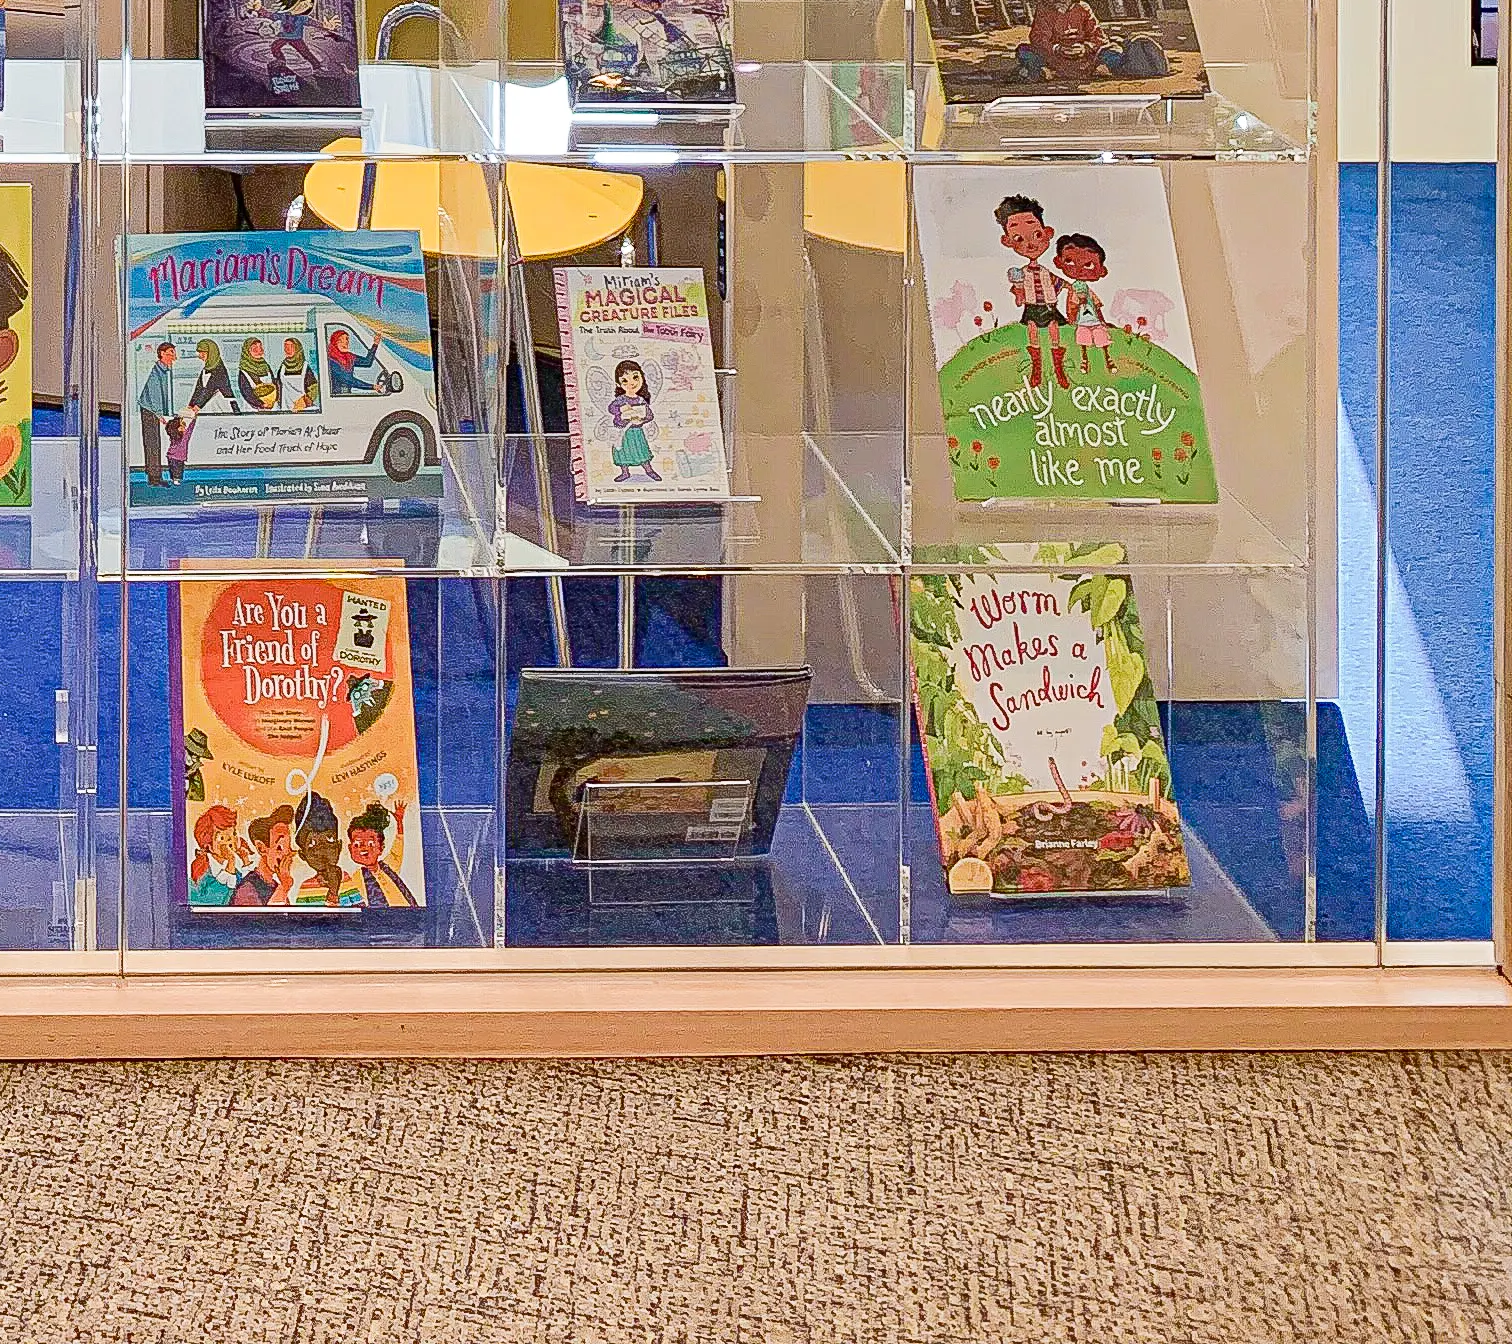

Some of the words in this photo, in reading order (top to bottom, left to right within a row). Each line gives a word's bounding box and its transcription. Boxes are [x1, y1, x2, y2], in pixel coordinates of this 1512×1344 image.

[148, 246, 281, 303] Mariam's
[286, 247, 384, 309] Dream
[604, 273, 660, 290] Miriam's
[585, 286, 686, 308] MAGICAL
[579, 326, 593, 334] The
[580, 306, 657, 323] CREATURE
[662, 305, 699, 318] FILES
[969, 375, 1054, 429] nearly
[1071, 384, 1176, 435] exactly
[230, 426, 256, 441] Story
[1035, 414, 1128, 447] almost
[217, 446, 233, 454] and
[236, 444, 252, 454] Her
[254, 443, 276, 454] Food
[278, 444, 303, 454] Truck
[1030, 449, 1084, 486] like
[1094, 456, 1144, 485] me
[232, 597, 266, 626] Are
[264, 592, 309, 631] You
[316, 603, 327, 625] a
[346, 595, 387, 611] WANTED
[970, 588, 1061, 629] Worm
[220, 629, 297, 667] Friend
[301, 631, 320, 667] of
[340, 650, 382, 666] DOROTHY
[963, 622, 1060, 681] Makes
[1072, 642, 1087, 661] a
[243, 666, 344, 708] Dorothy?
[989, 666, 1105, 730] Sandwich
[222, 762, 245, 778] KYLE
[331, 771, 351, 785] LEVI
[349, 750, 388, 777] HASTINGS
[1035, 840, 1070, 848] Brianne
[1071, 840, 1099, 850] Farley
